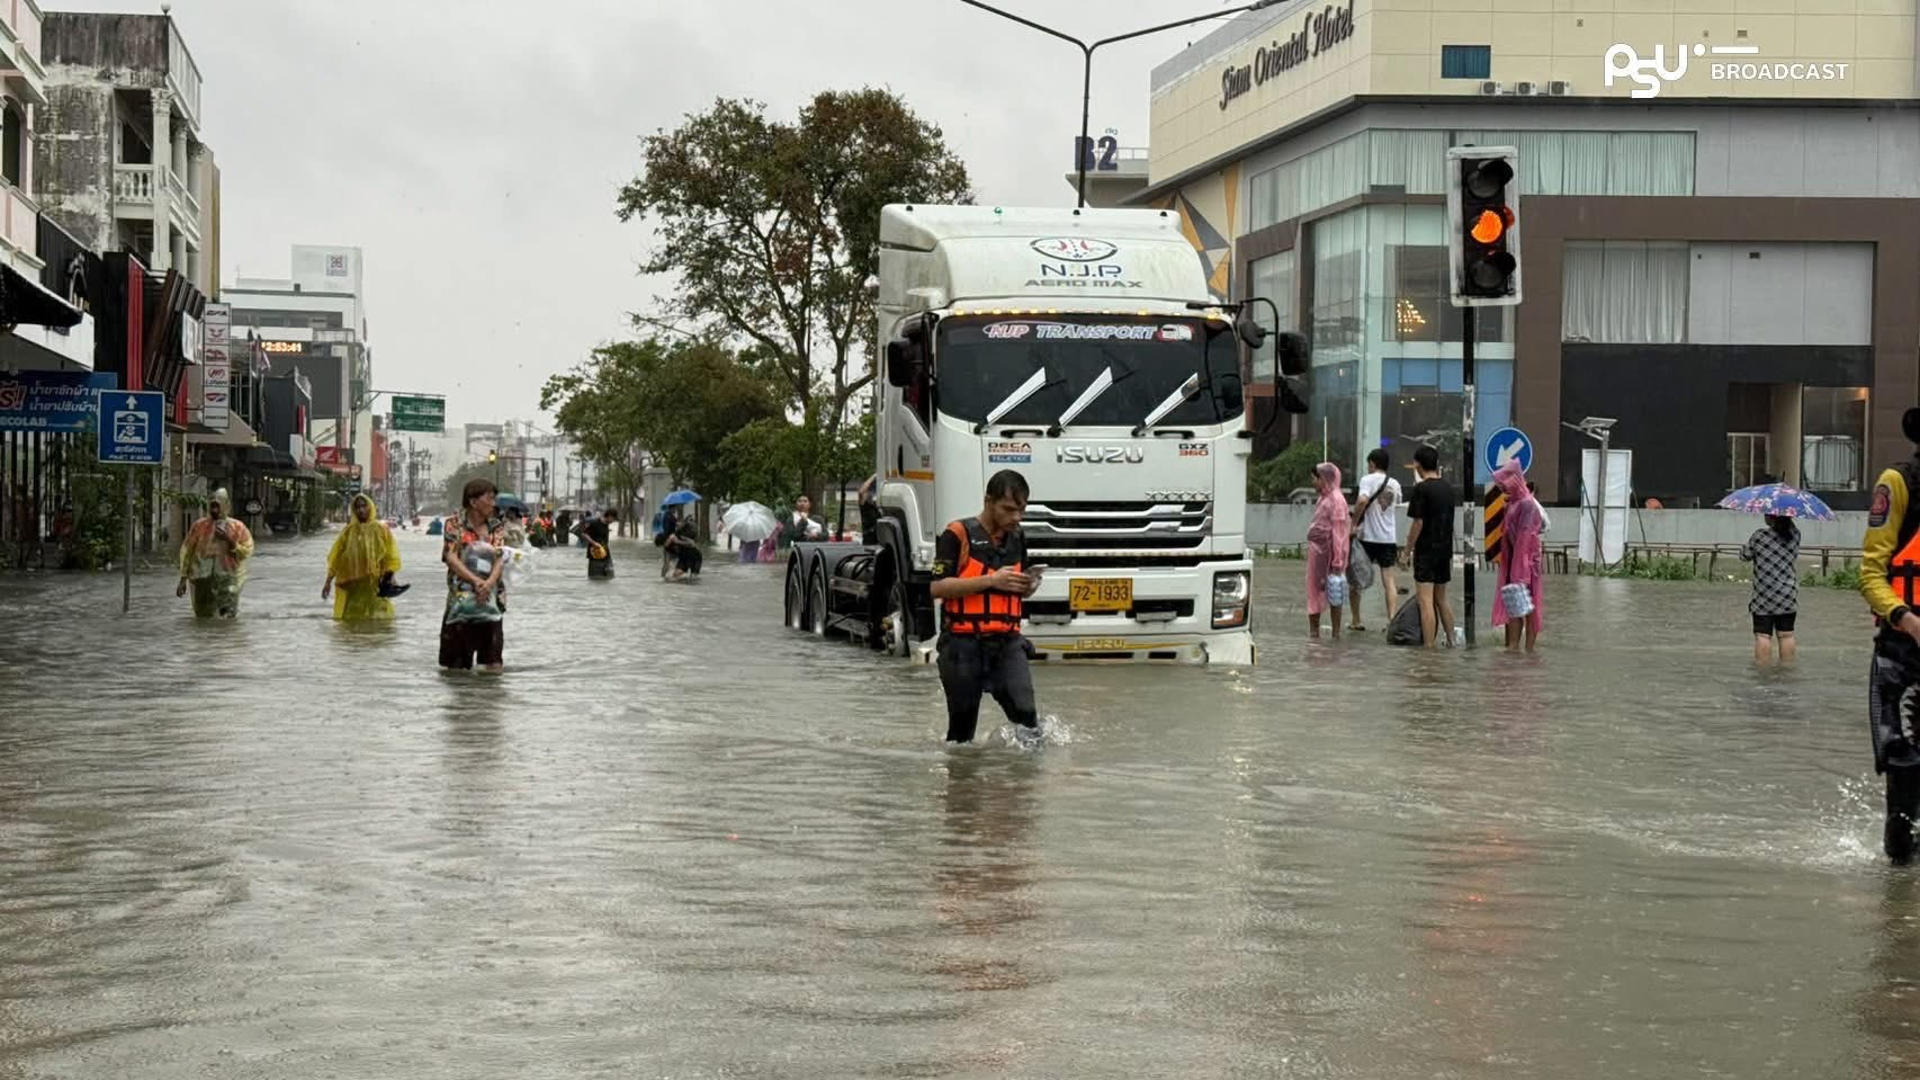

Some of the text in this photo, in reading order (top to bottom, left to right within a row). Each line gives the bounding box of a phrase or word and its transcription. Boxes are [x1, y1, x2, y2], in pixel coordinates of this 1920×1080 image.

[1219, 0, 1355, 111] Siam Oriental Hotel
[1075, 135, 1118, 171] B2
[1025, 279, 1143, 289] AERO MAX
[1035, 324, 1158, 340] TRANSPORT
[1056, 445, 1144, 464] ISUZU
[1073, 585, 1130, 602] 72-1933
[1074, 638, 1127, 650] ISUZU
